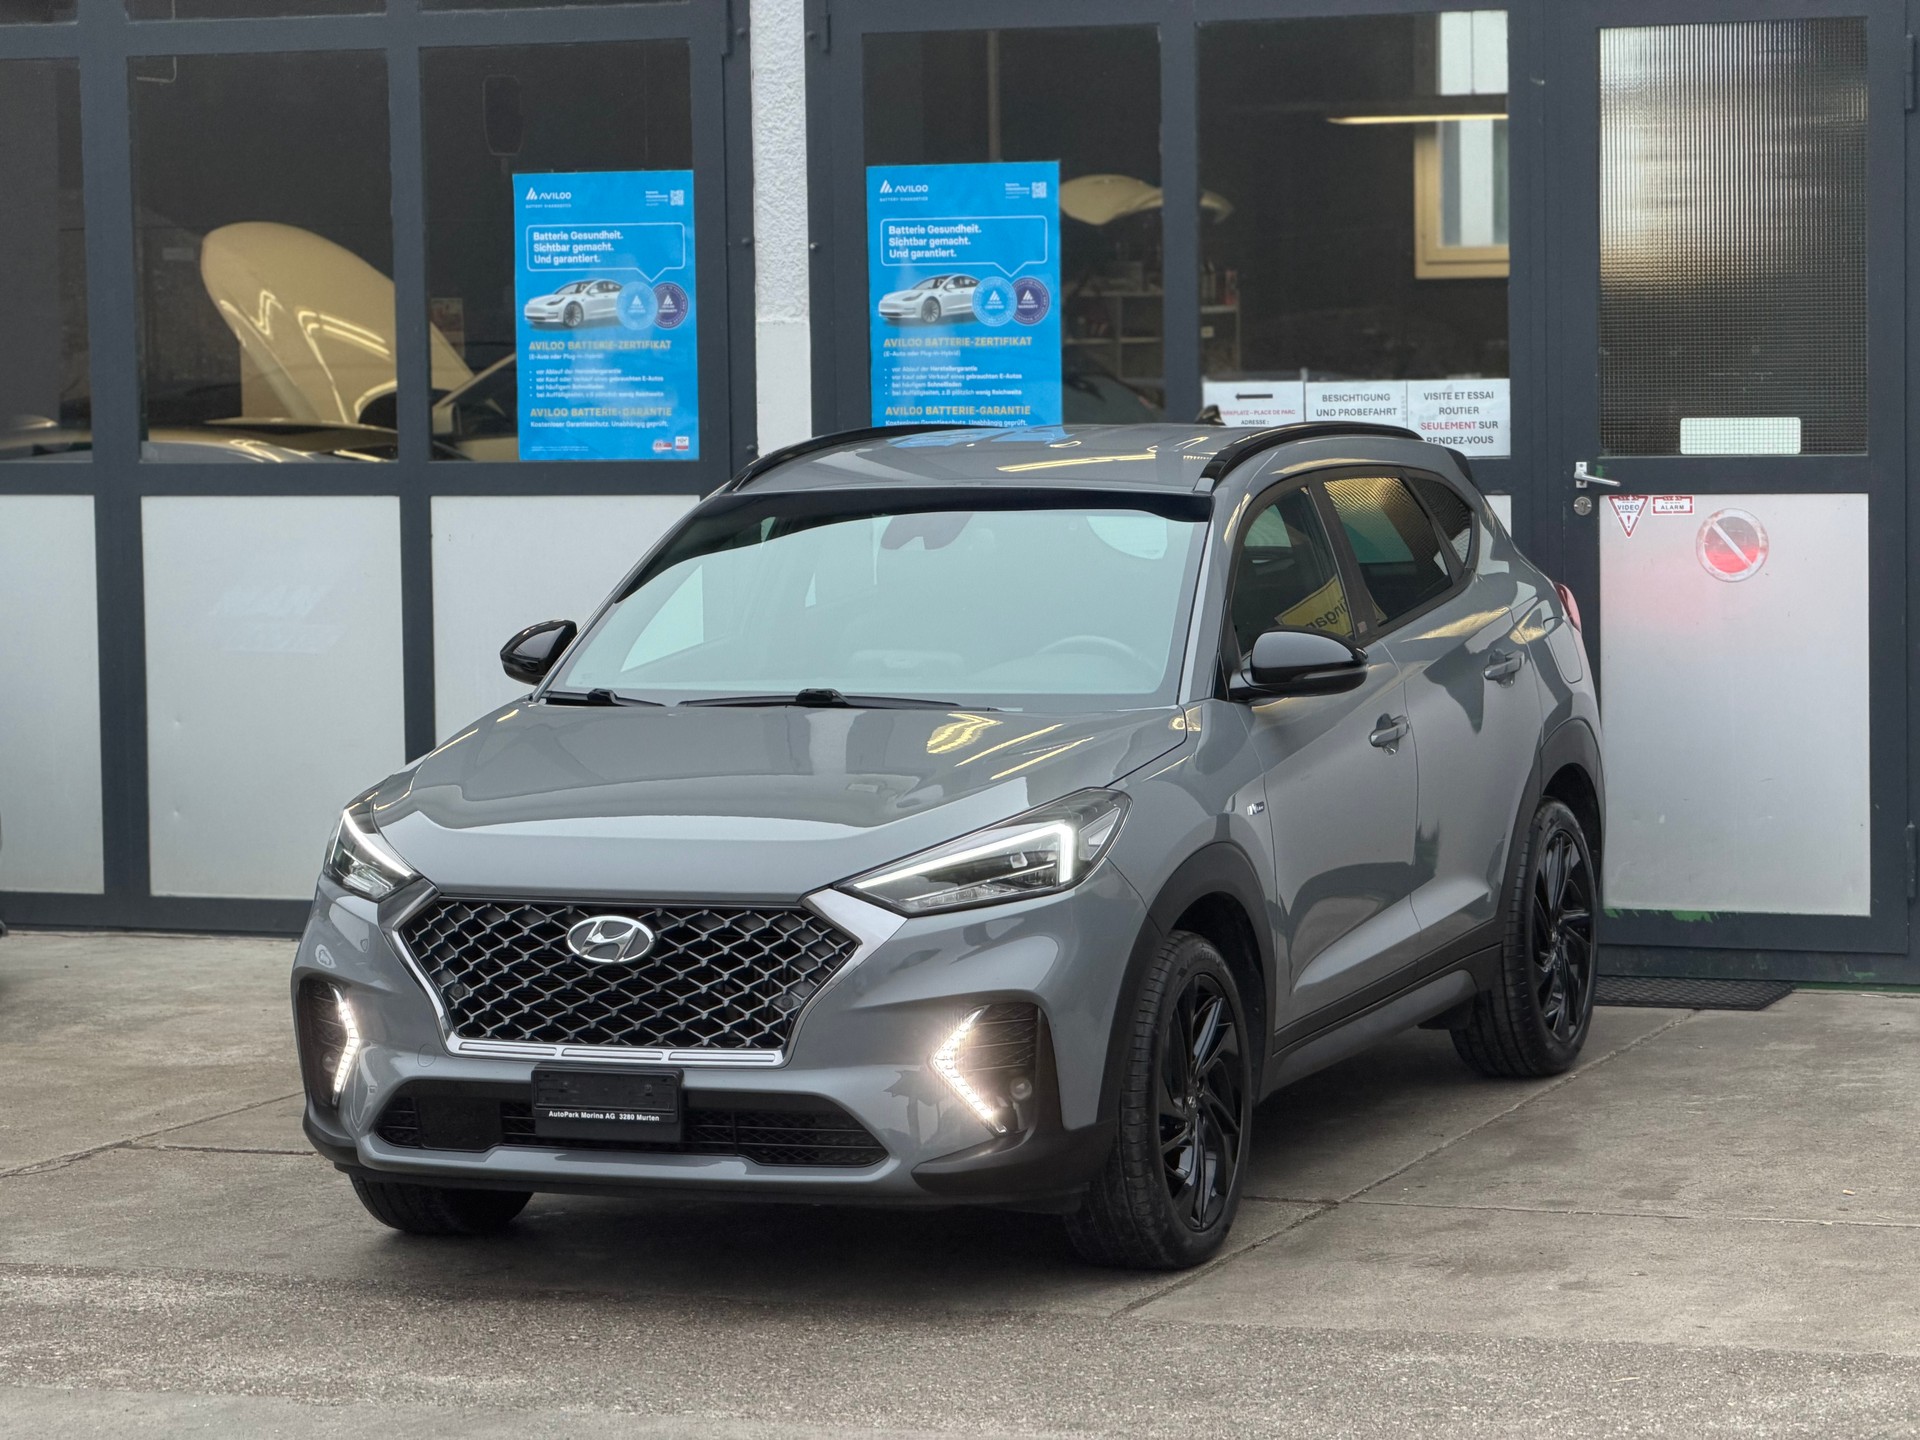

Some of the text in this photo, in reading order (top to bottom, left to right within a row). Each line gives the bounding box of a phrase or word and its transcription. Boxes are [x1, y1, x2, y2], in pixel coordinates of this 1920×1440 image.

[895, 184, 928, 192] AVILOO
[889, 224, 982, 234] Batterie Gesundheit.
[533, 231, 623, 240] Batterie Gesundheit.
[534, 242, 614, 253] Sichtbar gemacht.
[889, 237, 970, 248] Sichtbar gemacht.
[890, 248, 956, 260] Und garantiert.
[534, 254, 600, 265] Und garantiert.
[529, 342, 564, 350] AVILOO
[884, 337, 1032, 347] AVILOO BATTERIE-ZERTIFIKAT
[1322, 393, 1391, 403] BESICHTIGUNG
[1423, 391, 1494, 401] VISITE ET ESSAI
[531, 407, 672, 417] AVILOO BATTERIE-GARANTIE
[886, 406, 1031, 415] AVILOO BATTERIE-GARANTIE
[1316, 407, 1397, 417] UND PROBEFAHRT
[1439, 406, 1479, 415] ROUTIER
[1420, 421, 1498, 431] SEULEMENT SUR
[1426, 435, 1494, 445] RENDEZ-VOUS
[549, 1111, 579, 1119] AutoPark
